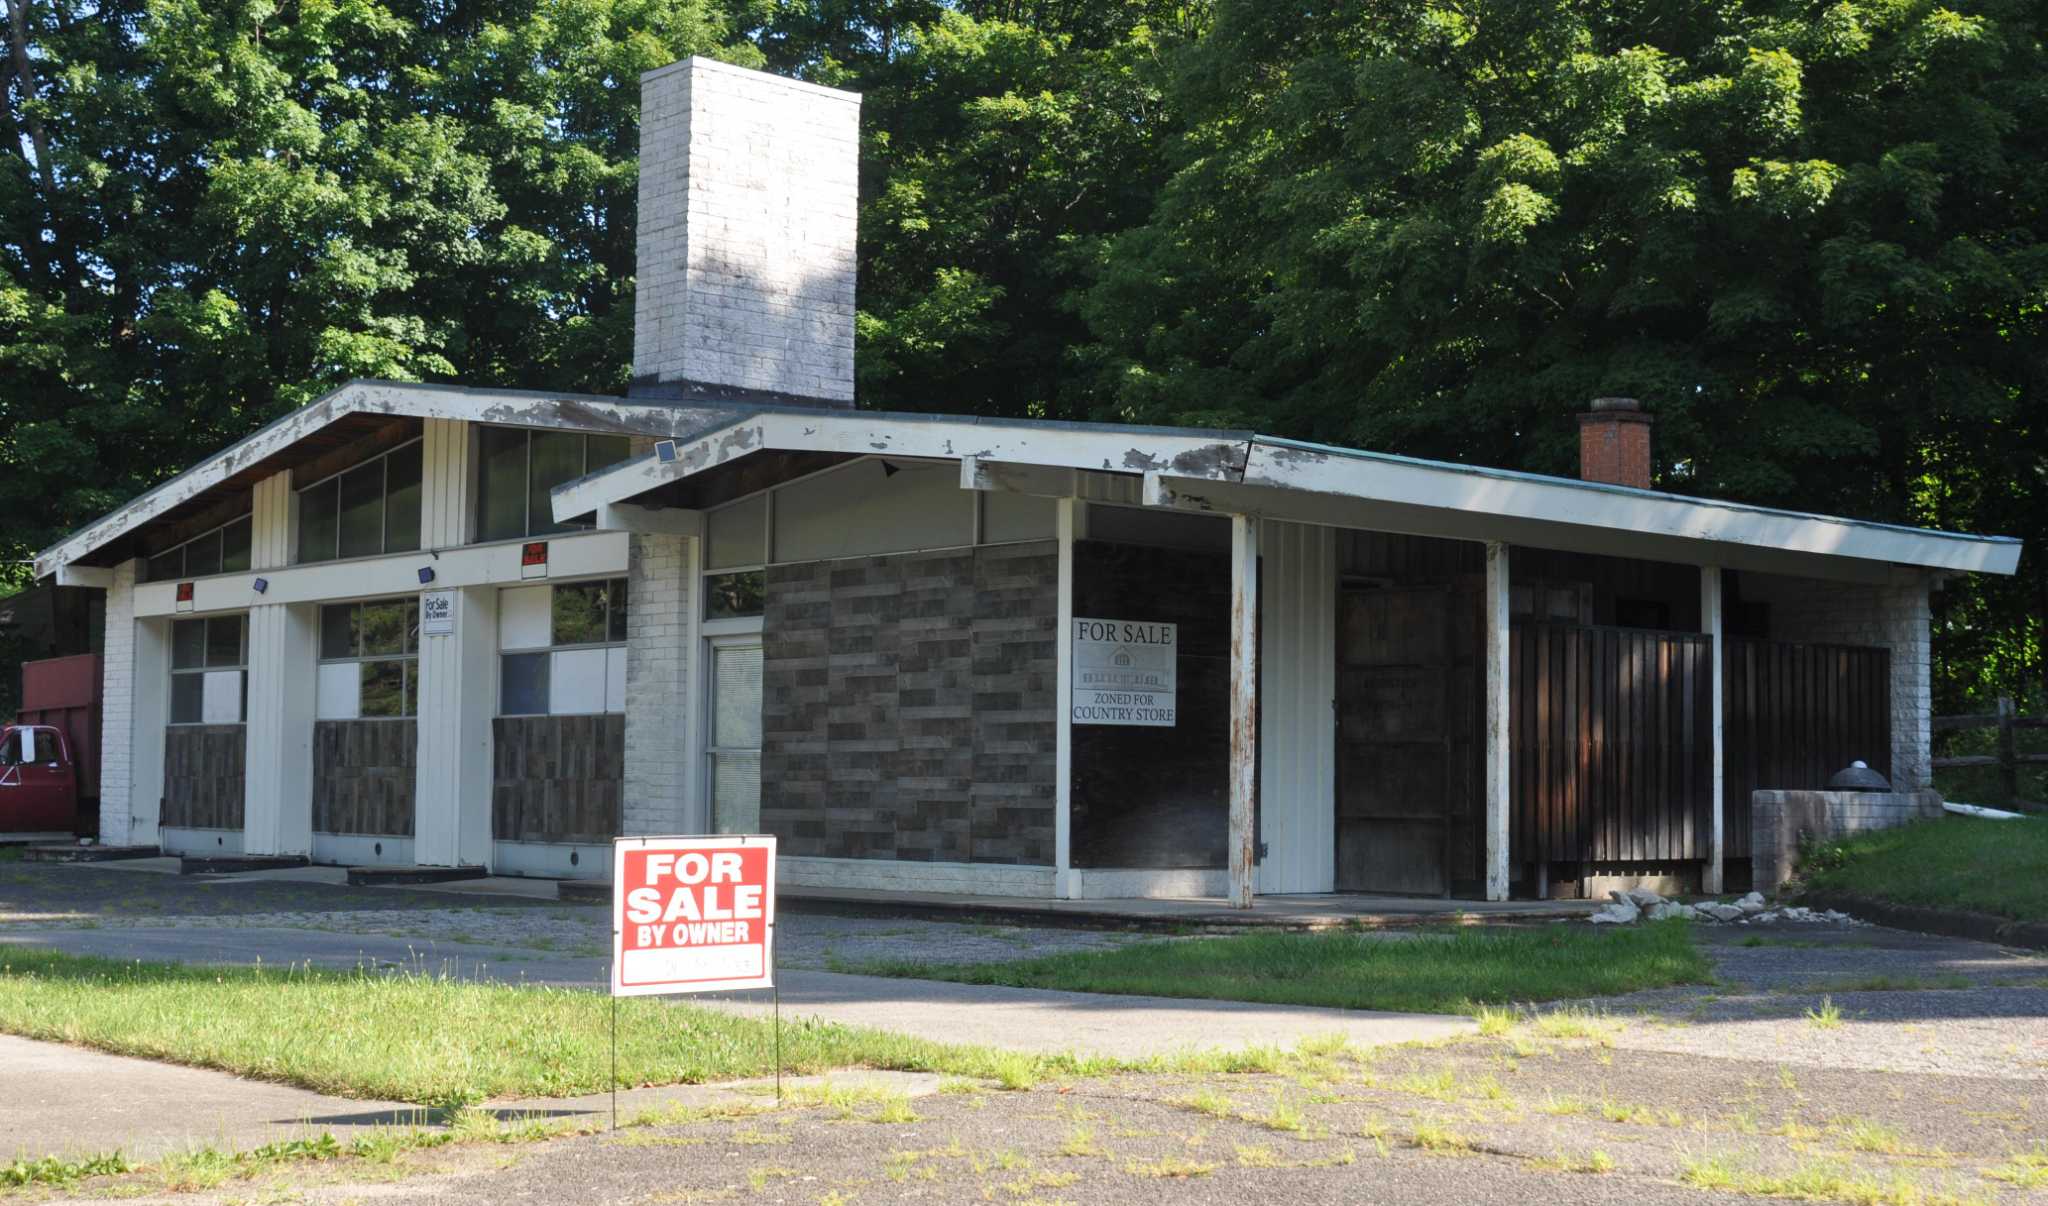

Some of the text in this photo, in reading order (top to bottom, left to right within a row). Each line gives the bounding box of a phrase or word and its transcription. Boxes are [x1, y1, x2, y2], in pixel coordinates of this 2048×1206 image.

[425, 598, 449, 610] For Sale
[1078, 622, 1172, 645] FOR SALE
[1095, 693, 1154, 706] ZONED FOR
[1073, 706, 1174, 721] COUNTRY STORE
[646, 852, 743, 885] FOR
[627, 885, 762, 924] SALE
[637, 921, 749, 947] BY OWNER
